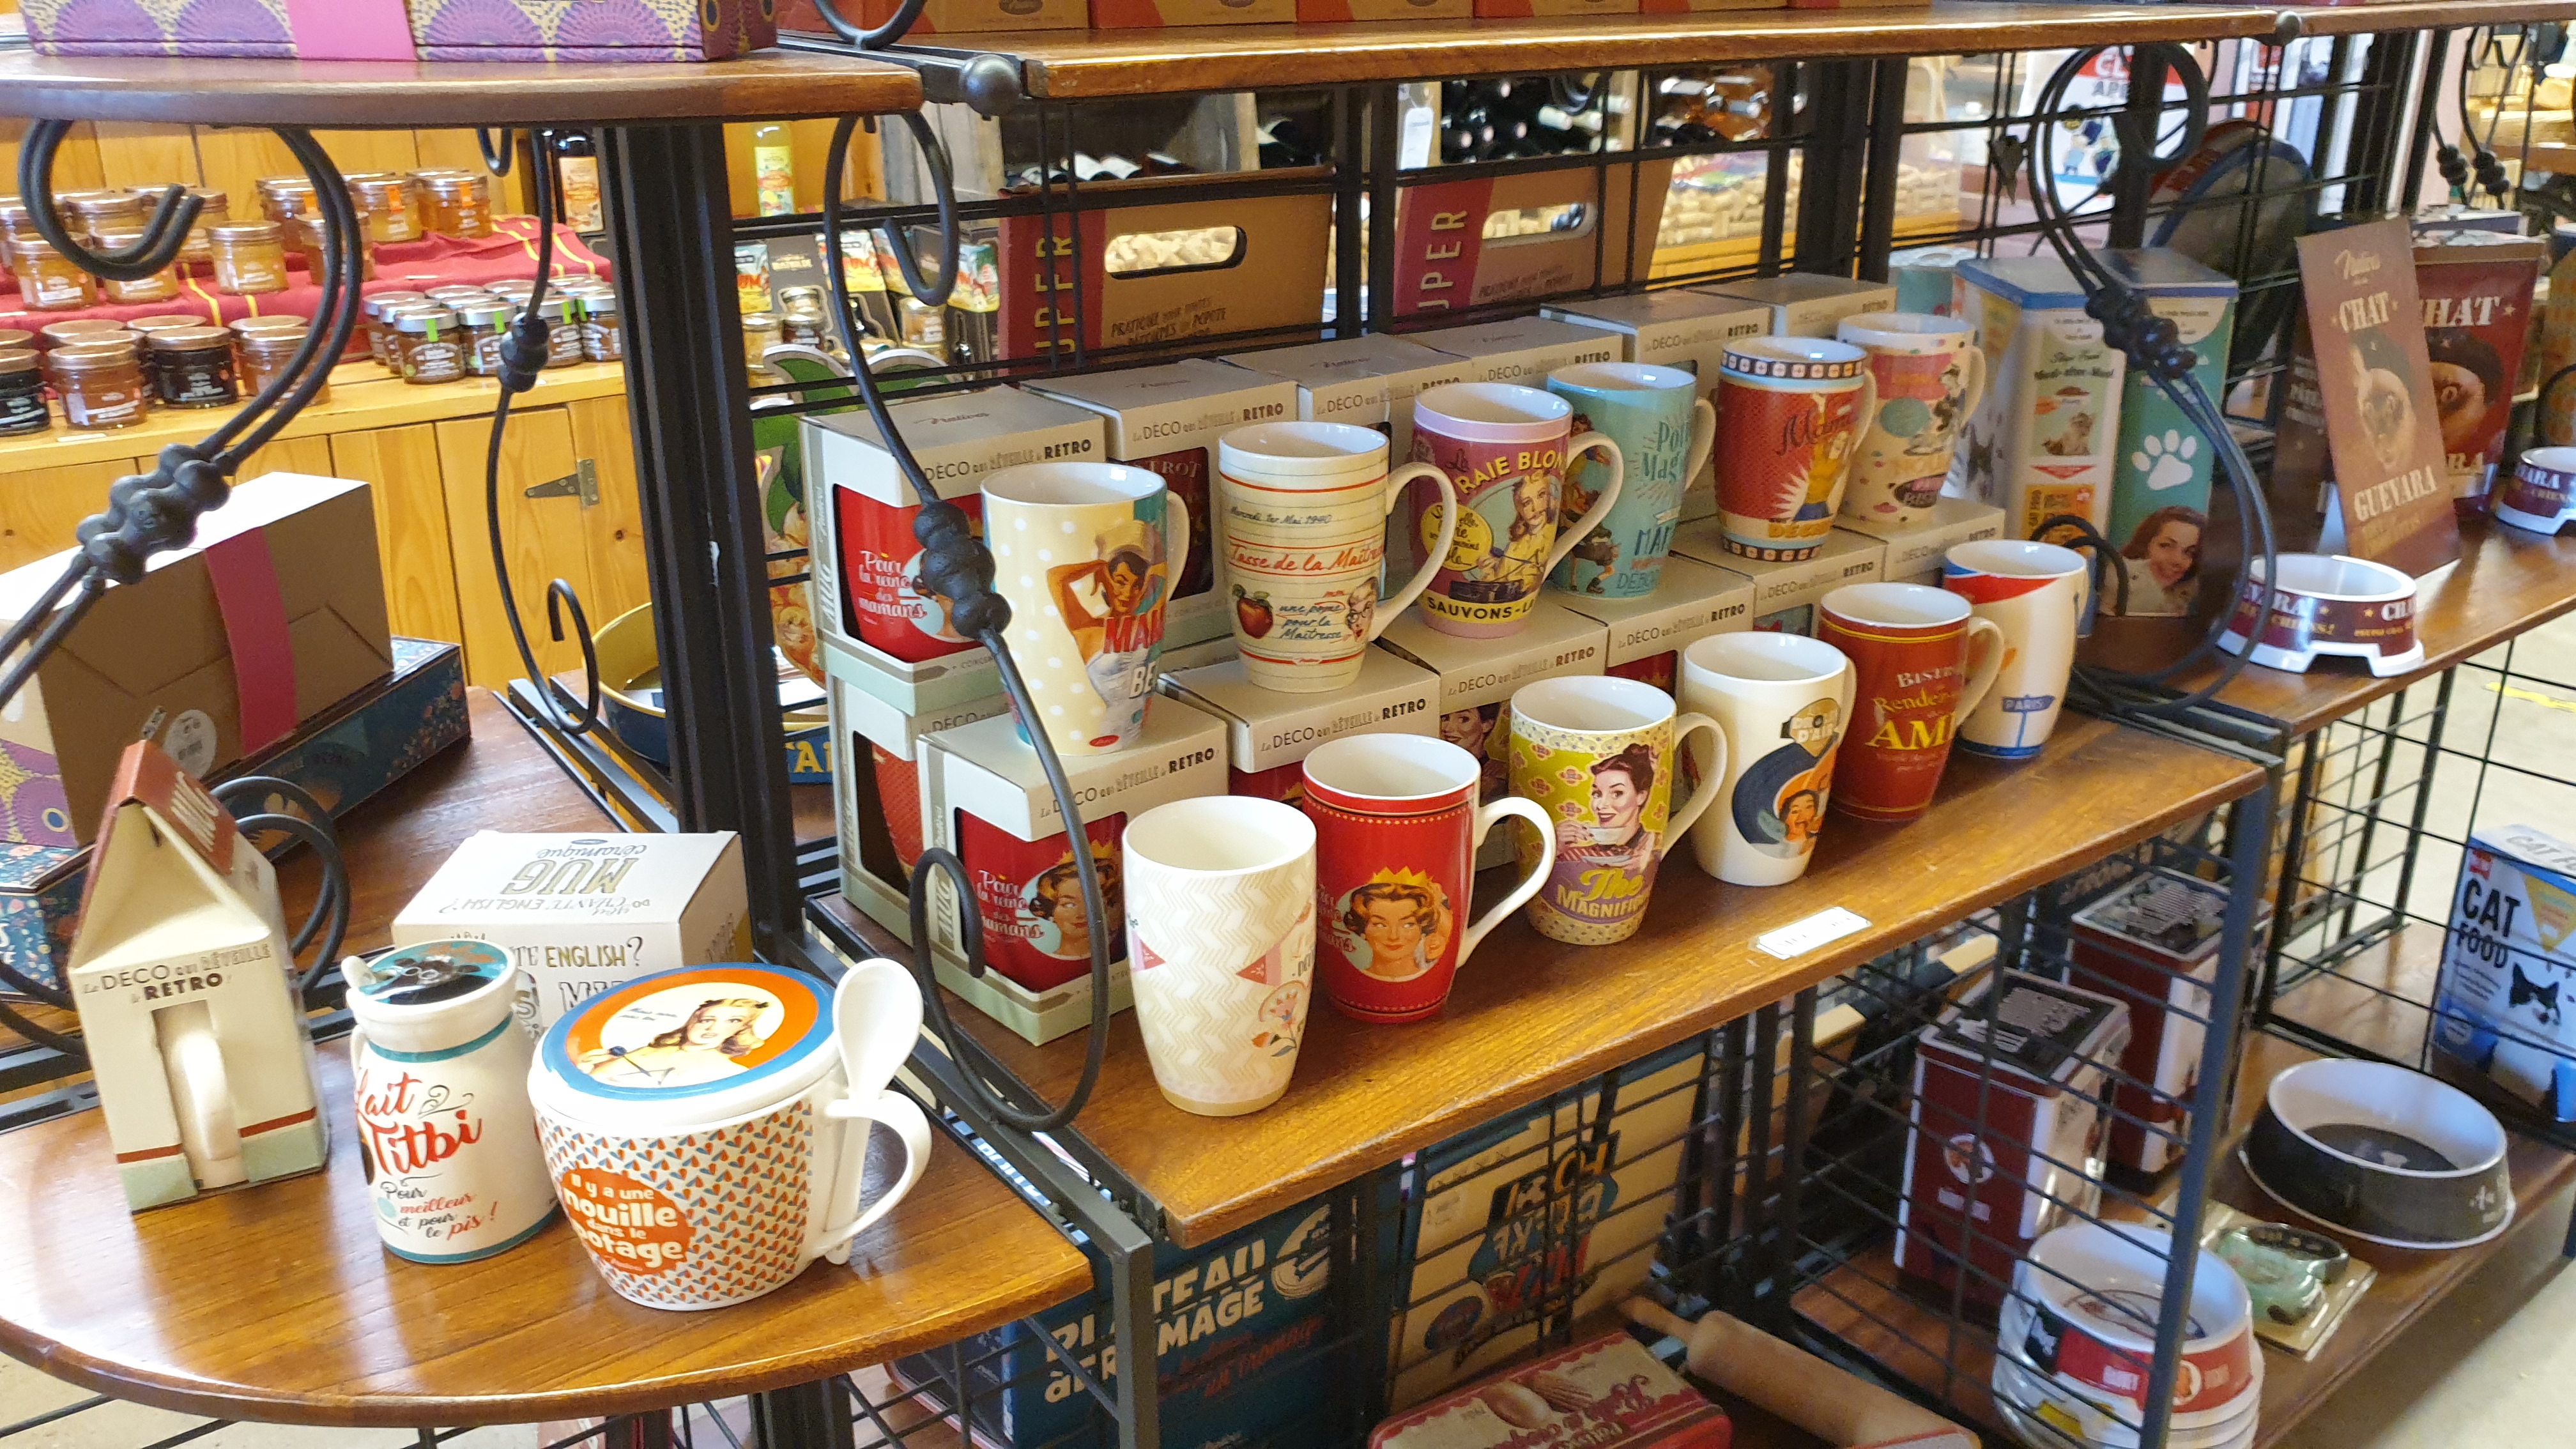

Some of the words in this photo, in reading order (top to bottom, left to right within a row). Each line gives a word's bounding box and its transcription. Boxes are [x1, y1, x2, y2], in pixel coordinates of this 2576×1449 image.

[2338, 291, 2390, 334] CHAT
[2419, 296, 2501, 328] HAT
[1727, 323, 1759, 337] RETRO
[1574, 351, 1611, 364] RETRO
[1243, 402, 1284, 422] RETRO
[1044, 439, 1092, 459] RETRO
[1273, 553, 1298, 571] de
[1302, 553, 1324, 571] la
[1843, 560, 1874, 578] RETRO
[1710, 603, 1746, 623] RETRO
[1555, 645, 1596, 667] RETRO
[1381, 698, 1427, 721] RETRO
[1052, 787, 1098, 814] DCO
[1168, 747, 1215, 774] RETRO
[500, 857, 639, 895] MUG
[1579, 868, 1644, 901] The
[2462, 878, 2521, 939] CAT
[2456, 922, 2510, 970] FOOD
[143, 972, 224, 1002] RETRO
[379, 1181, 428, 1201] Pour
[586, 1183, 598, 1199] y
[603, 1187, 615, 1199] a
[618, 1185, 656, 1200] une
[399, 1192, 474, 1215] meilleur
[562, 1187, 678, 1229] nouille
[398, 1214, 412, 1228] et
[417, 1212, 457, 1230] pour
[425, 1226, 443, 1239] le
[447, 1213, 482, 1242] pis
[629, 1225, 647, 1241] le
